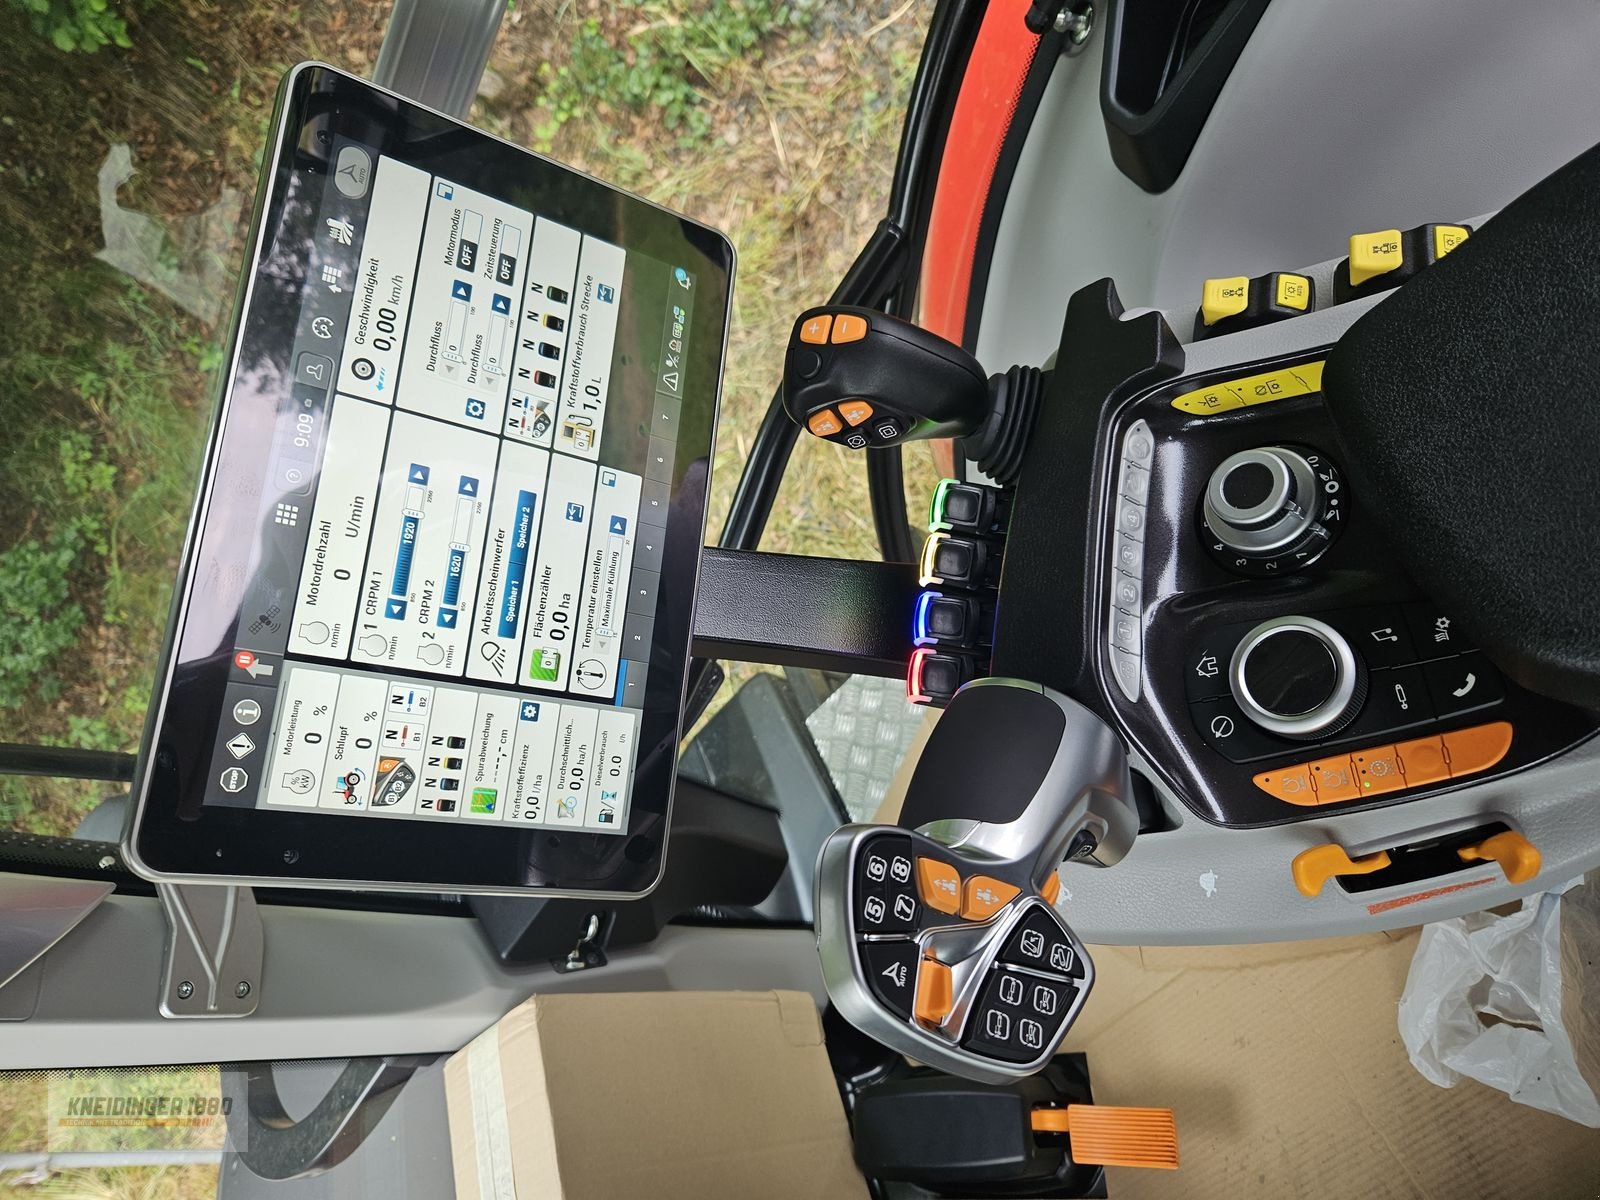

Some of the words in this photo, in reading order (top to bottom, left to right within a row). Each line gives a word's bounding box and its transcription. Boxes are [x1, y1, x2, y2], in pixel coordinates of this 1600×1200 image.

[358, 168, 366, 184] AUTO
[444, 209, 461, 265] Motormodus
[462, 245, 472, 266] OFF
[484, 219, 502, 280] Zeitsteuerung
[501, 259, 512, 280] OFF
[531, 282, 543, 293] N
[355, 258, 379, 345] Geschwindigkeit
[373, 308, 396, 351] 0,00
[387, 275, 403, 305] km/h
[527, 311, 539, 322] N
[426, 321, 442, 372] Durchfluss
[523, 339, 534, 350] N
[567, 314, 588, 408] Kraftstoffverbrauch
[581, 276, 593, 311] Strecke
[467, 334, 483, 384] Durchfluss
[519, 368, 530, 379] N
[512, 398, 522, 408] N
[583, 385, 601, 411] 1,0
[294, 414, 313, 448] 9:09
[509, 418, 519, 428] N
[517, 514, 530, 548] Speicher
[1128, 516, 1137, 524] 4
[334, 569, 350, 580] 0
[345, 496, 364, 538] U/min
[404, 522, 415, 544] 1920
[306, 521, 331, 606] Motordrehzahl
[450, 556, 461, 577] 1620
[1124, 551, 1133, 560] 3
[607, 551, 619, 585] Kühlung
[481, 528, 505, 635] Arbeitsscheinwerfer
[1124, 588, 1133, 597] 2
[366, 579, 380, 615] CRPM
[418, 590, 433, 624] CRPM
[505, 587, 518, 622] Speicher
[533, 565, 552, 638] Flächenzähler
[559, 593, 571, 608] ha
[582, 597, 598, 649] Temperatur
[590, 550, 603, 594] einstellen
[601, 587, 615, 627] Maximale
[330, 623, 341, 648] n/min
[549, 611, 571, 641] 0,0
[387, 636, 398, 660] n/min
[444, 645, 455, 668] n/min
[392, 696, 404, 704] N
[419, 697, 427, 707] B2
[283, 700, 301, 755] Motorleistung
[304, 733, 321, 744] 0
[313, 706, 328, 716] %
[356, 738, 372, 749] 0
[364, 712, 377, 721] %
[385, 730, 398, 740] N
[334, 726, 348, 760] Schlupf
[413, 732, 421, 742] B1
[432, 736, 443, 745] N
[475, 713, 493, 782] Spurabweichung
[499, 729, 508, 744] cm
[428, 757, 440, 766] N
[570, 768, 584, 790] 0,0
[577, 744, 586, 765] ha/h
[594, 731, 608, 786] Dieselverbrauch
[610, 756, 621, 777] 0.0
[229, 770, 238, 789] STOP
[299, 775, 310, 788] kW
[425, 779, 437, 787] N
[512, 745, 529, 819] Kraftstoffeffizienz
[532, 775, 543, 793] l/ha
[421, 800, 433, 809] N
[525, 797, 540, 820] 0,0
[871, 862, 882, 876] 6
[895, 863, 907, 877] 8
[870, 904, 880, 917] 5
[899, 901, 912, 914] 7
[899, 966, 907, 986] AUTO
